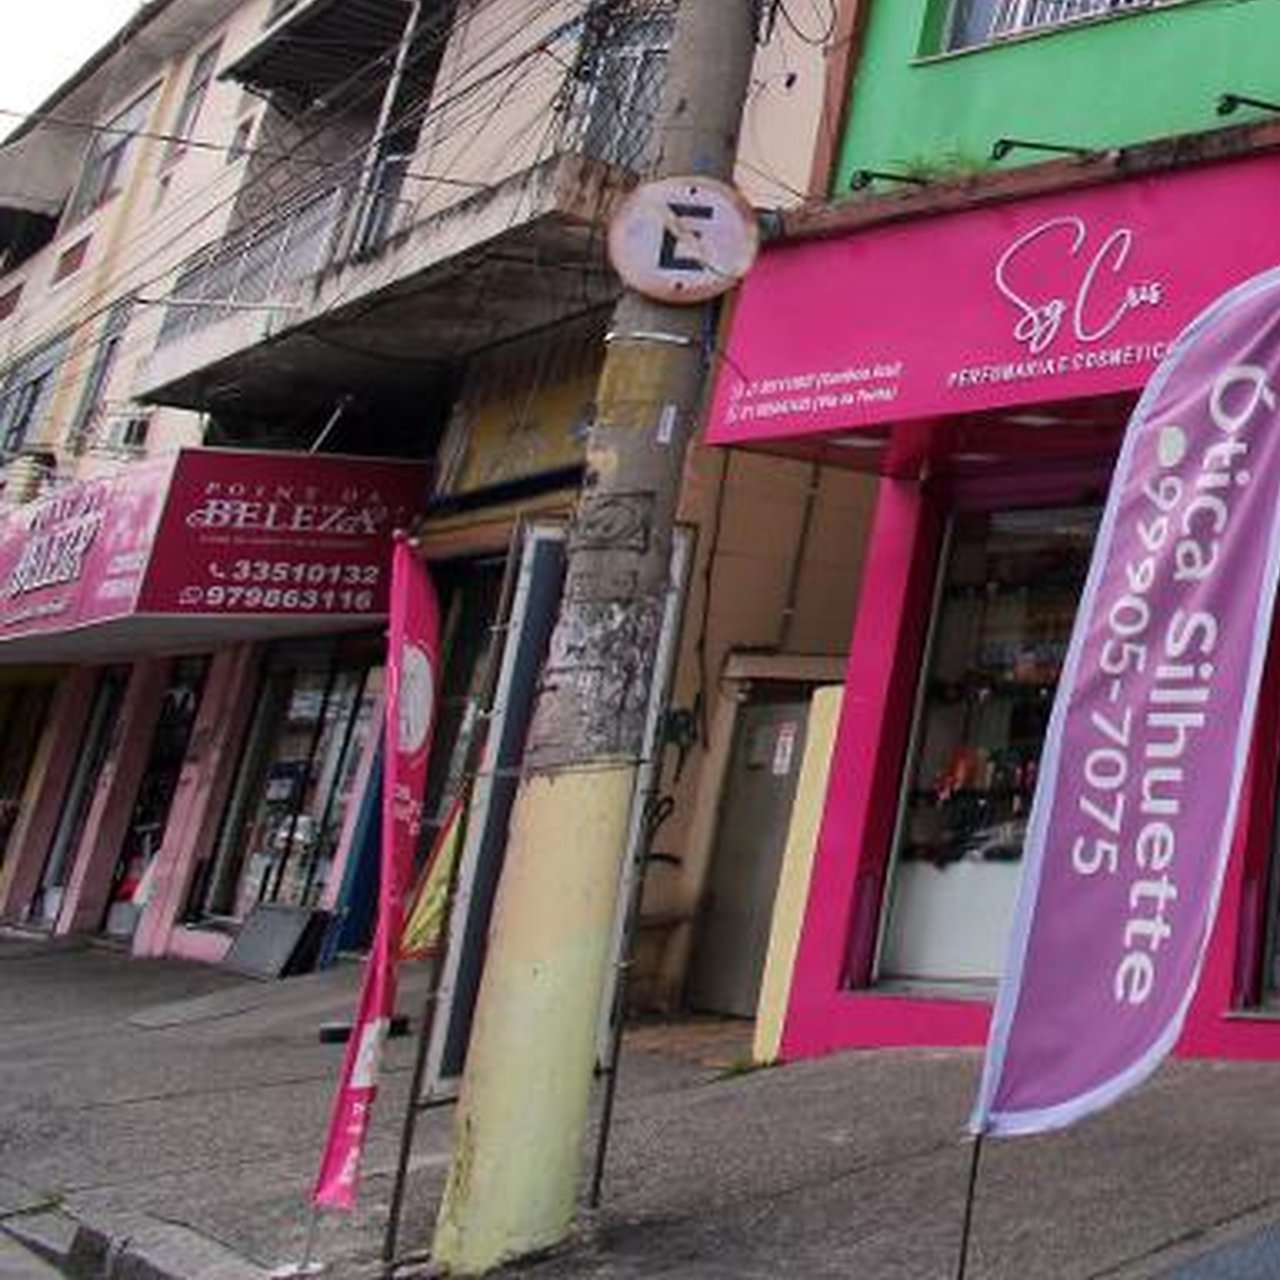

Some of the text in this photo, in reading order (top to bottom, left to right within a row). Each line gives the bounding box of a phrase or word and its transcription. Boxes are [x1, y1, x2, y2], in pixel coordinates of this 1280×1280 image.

[205, 481, 320, 503] POINT
[185, 498, 379, 535] BELEZA
[231, 559, 379, 585] 33510132
[206, 586, 374, 610] 979863116
[1072, 474, 1184, 876] 99905-7075
[1114, 363, 1277, 1005] Ótica Silhuette
